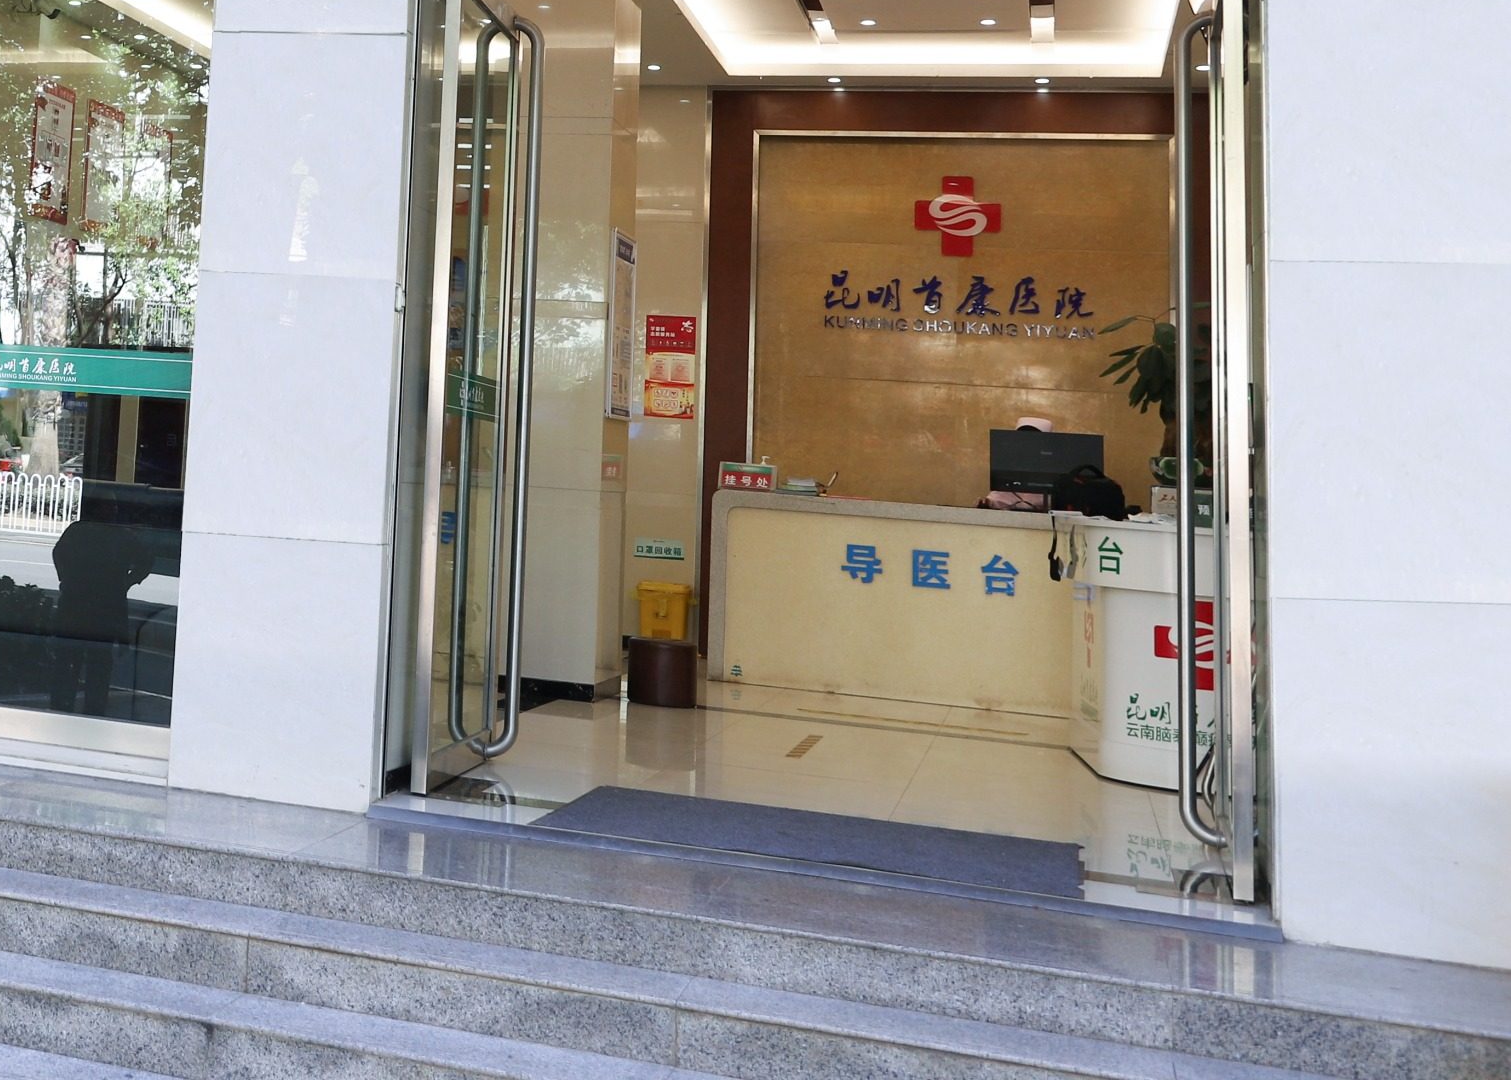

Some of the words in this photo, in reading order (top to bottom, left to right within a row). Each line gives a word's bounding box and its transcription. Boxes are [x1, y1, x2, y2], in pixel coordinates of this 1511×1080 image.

[824, 270, 1094, 320] 昆明首康医院
[824, 315, 908, 332] KUNMING
[912, 319, 1018, 337] SHOUKANG
[1023, 324, 1096, 340] YIYUAN
[18, 374, 52, 382] SHOUKANG
[724, 474, 768, 488] 挂号处
[636, 545, 682, 556] 口罩回收箱
[841, 544, 1019, 596] 导医台
